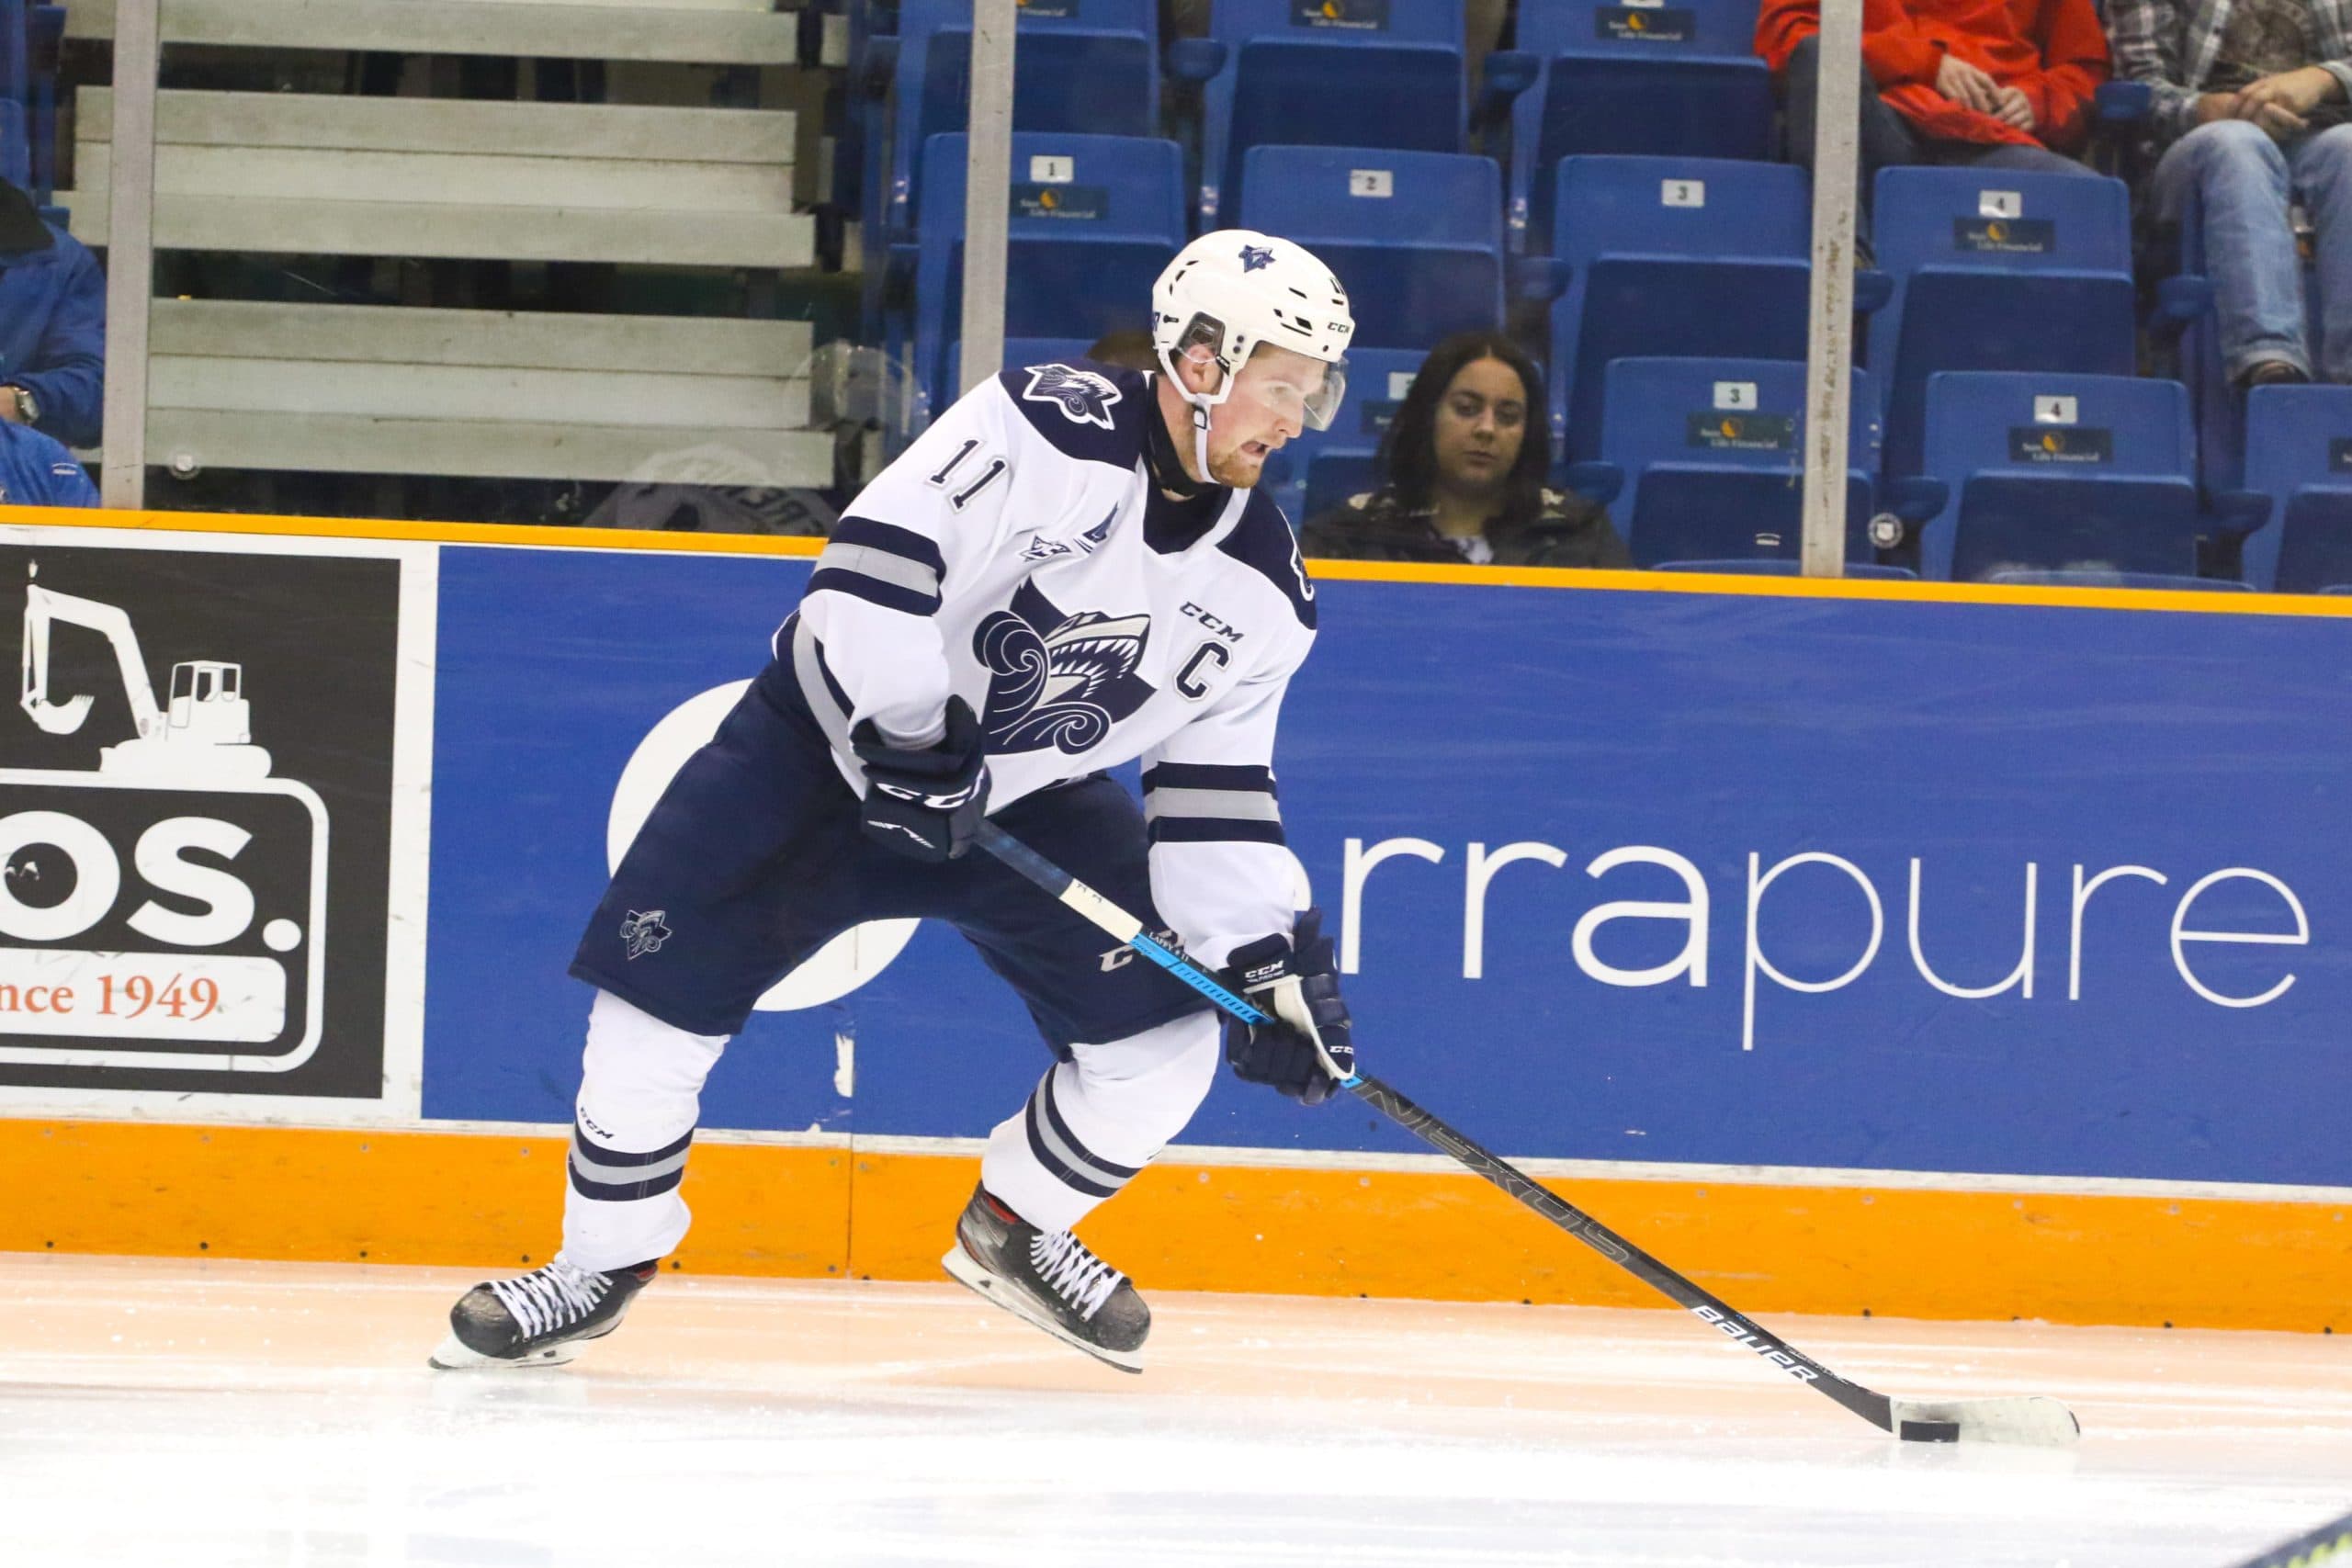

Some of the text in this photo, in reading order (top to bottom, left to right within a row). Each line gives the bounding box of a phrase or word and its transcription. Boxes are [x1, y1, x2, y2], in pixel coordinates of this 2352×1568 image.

[1366, 175, 1377, 191] 2
[1678, 185, 1689, 200] 3
[1729, 388, 1741, 403] 3
[2051, 401, 2062, 418] 4
[927, 437, 1008, 512] 11
[1179, 601, 1244, 642] CCM
[1174, 640, 1230, 700] C
[1288, 836, 2309, 1051] rrapure
[1245, 960, 1284, 978] CCM
[96, 973, 219, 1021] 1949
